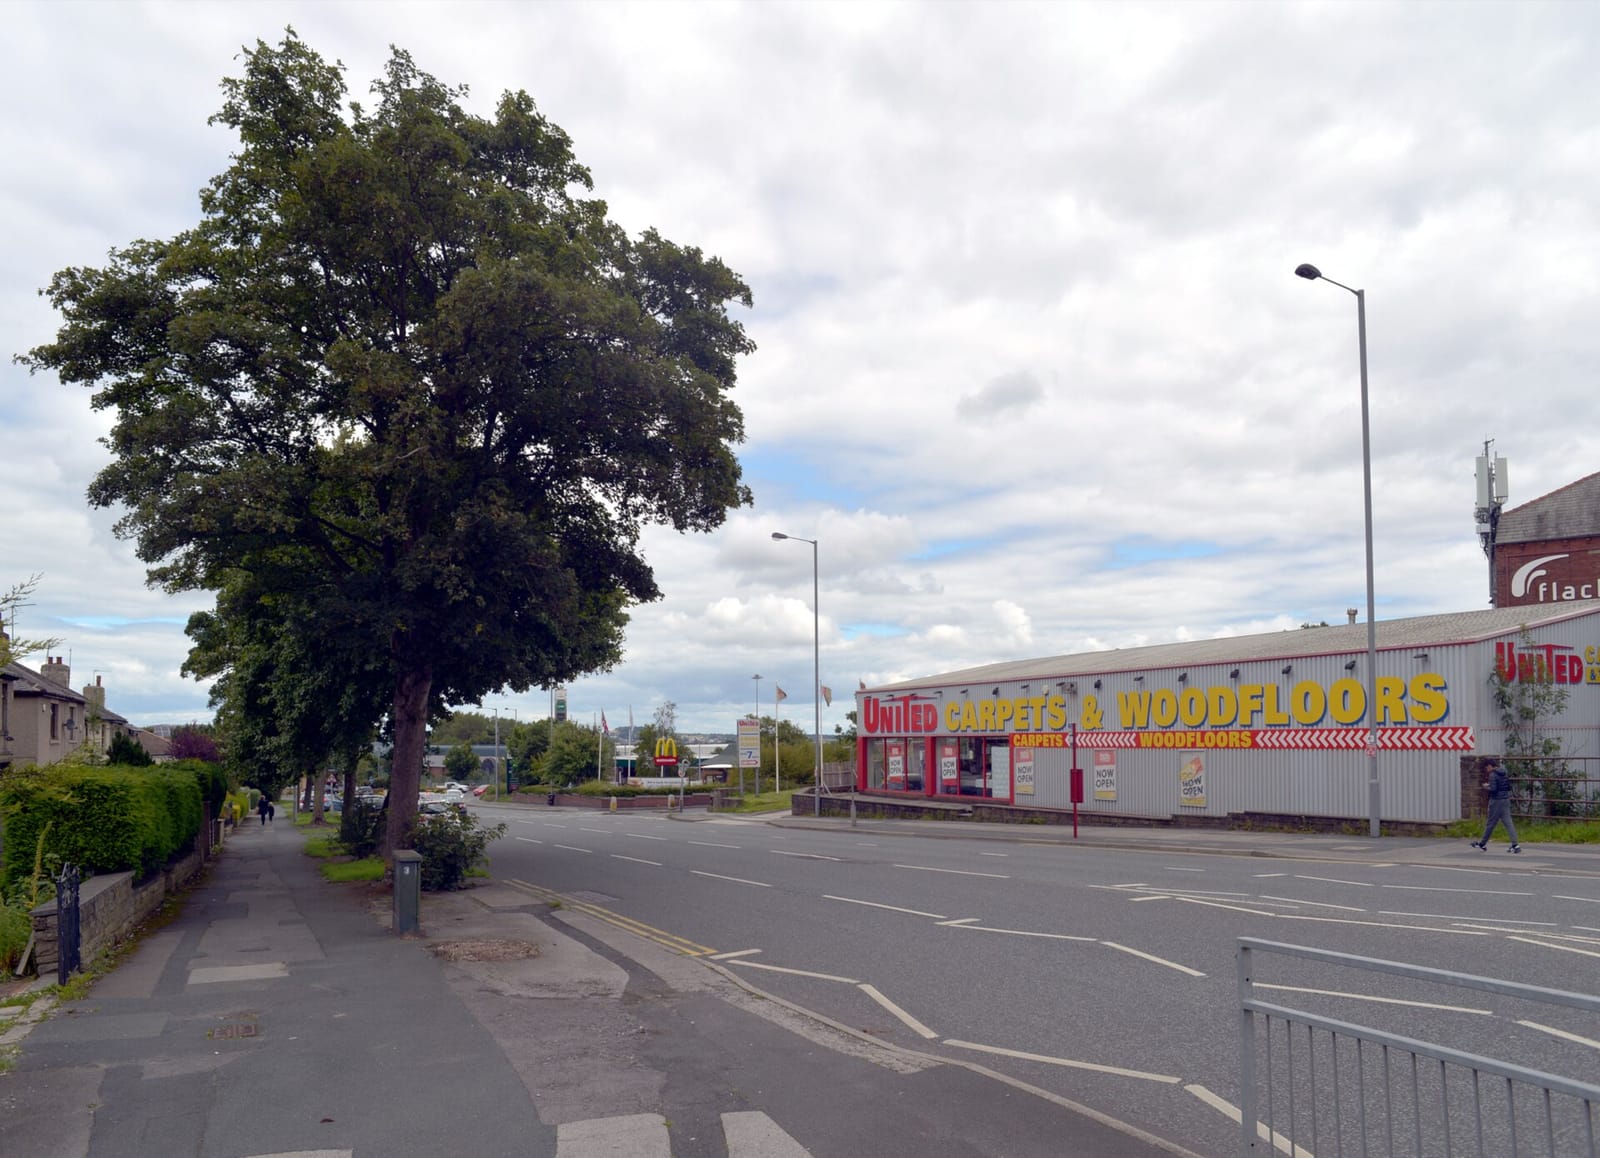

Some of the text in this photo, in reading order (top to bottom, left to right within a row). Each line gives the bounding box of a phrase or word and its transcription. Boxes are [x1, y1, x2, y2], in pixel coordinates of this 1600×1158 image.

[1538, 579, 1600, 601] flac
[944, 696, 1066, 732] CARPETS
[1081, 695, 1104, 731] &
[1117, 673, 1449, 730] WOODFLOORS
[1013, 734, 1063, 747] CARPETS
[1139, 731, 1251, 748] WOODFLOORS
[746, 751, 753, 759] 7
[943, 768, 956, 776] OPEN
[1017, 766, 1032, 774] NOW
[1096, 769, 1114, 778] NOW
[1016, 775, 1033, 783] OPEN
[1095, 779, 1115, 788] OPEN
[1182, 776, 1202, 787] NOW
[1182, 786, 1203, 795] OPEN
